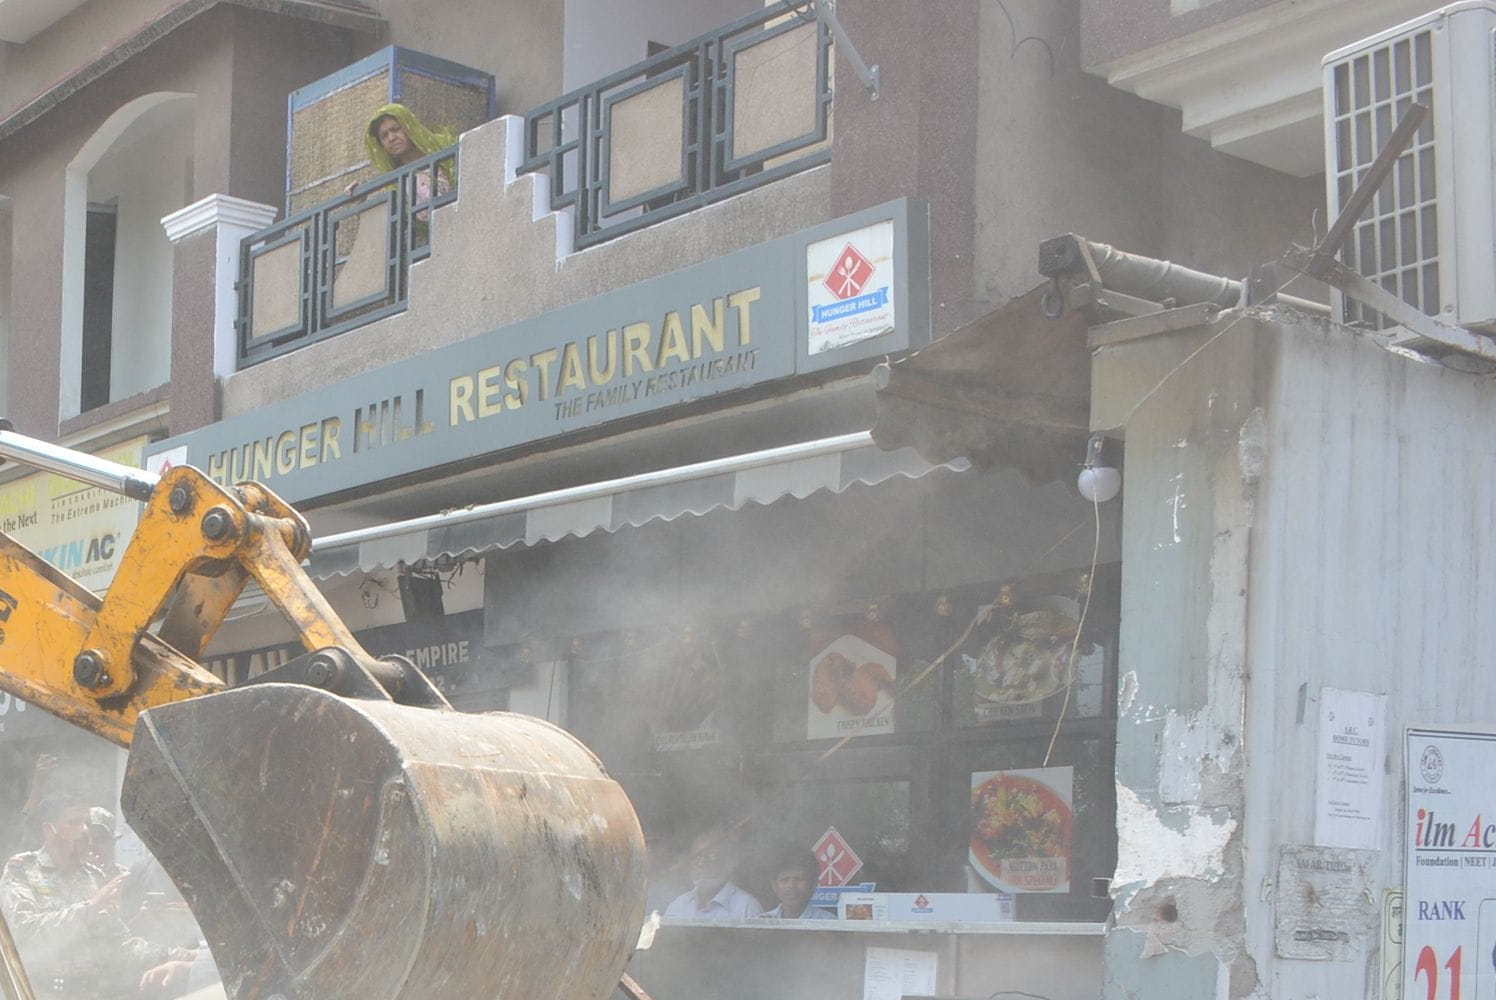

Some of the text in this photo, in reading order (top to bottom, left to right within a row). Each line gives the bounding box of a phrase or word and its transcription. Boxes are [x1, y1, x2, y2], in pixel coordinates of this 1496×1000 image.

[822, 298, 878, 318] HUNGER HILL
[208, 286, 761, 488] HUNGER HILL RESTAURANT
[554, 348, 760, 421] THE FAMILY RESTAURANT
[3, 511, 38, 533] the Next
[51, 512, 65, 526] The
[67, 503, 100, 522] Extreme
[86, 533, 115, 564] AC
[405, 640, 470, 669] EMPIRE
[1415, 808, 1456, 848] ilm
[1415, 855, 1487, 868] Foundation NEET
[1418, 900, 1467, 921] RANK
